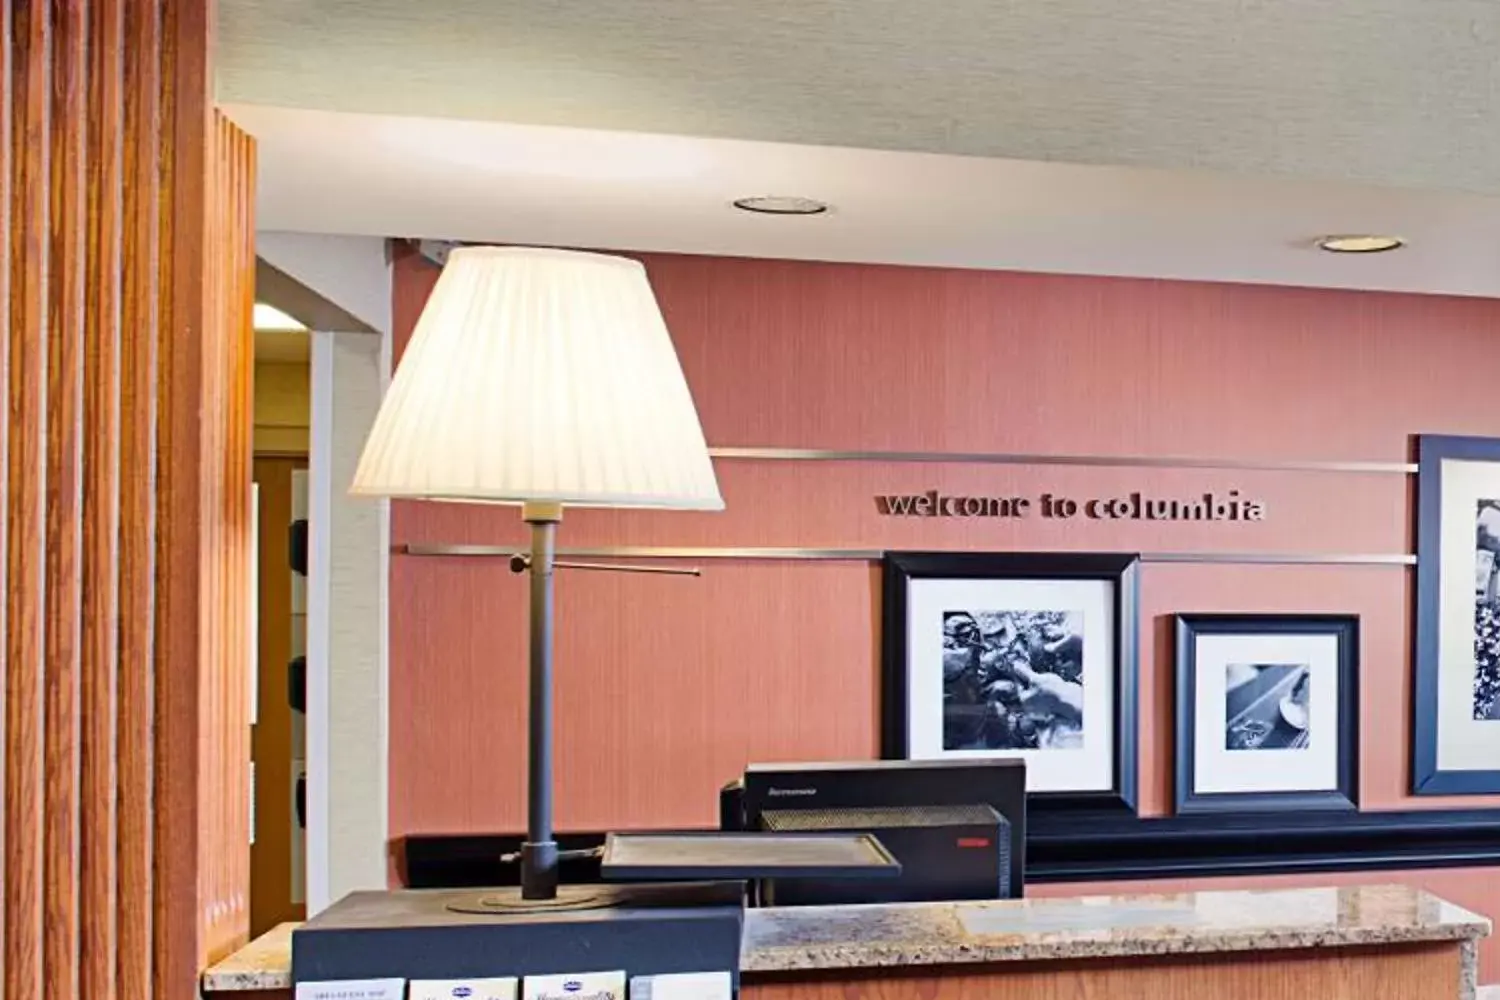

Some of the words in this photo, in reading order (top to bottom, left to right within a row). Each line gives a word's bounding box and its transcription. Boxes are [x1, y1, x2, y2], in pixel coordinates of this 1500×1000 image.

[873, 490, 1031, 518] welcome
[1040, 493, 1079, 519] to
[1085, 490, 1266, 521] columbia
